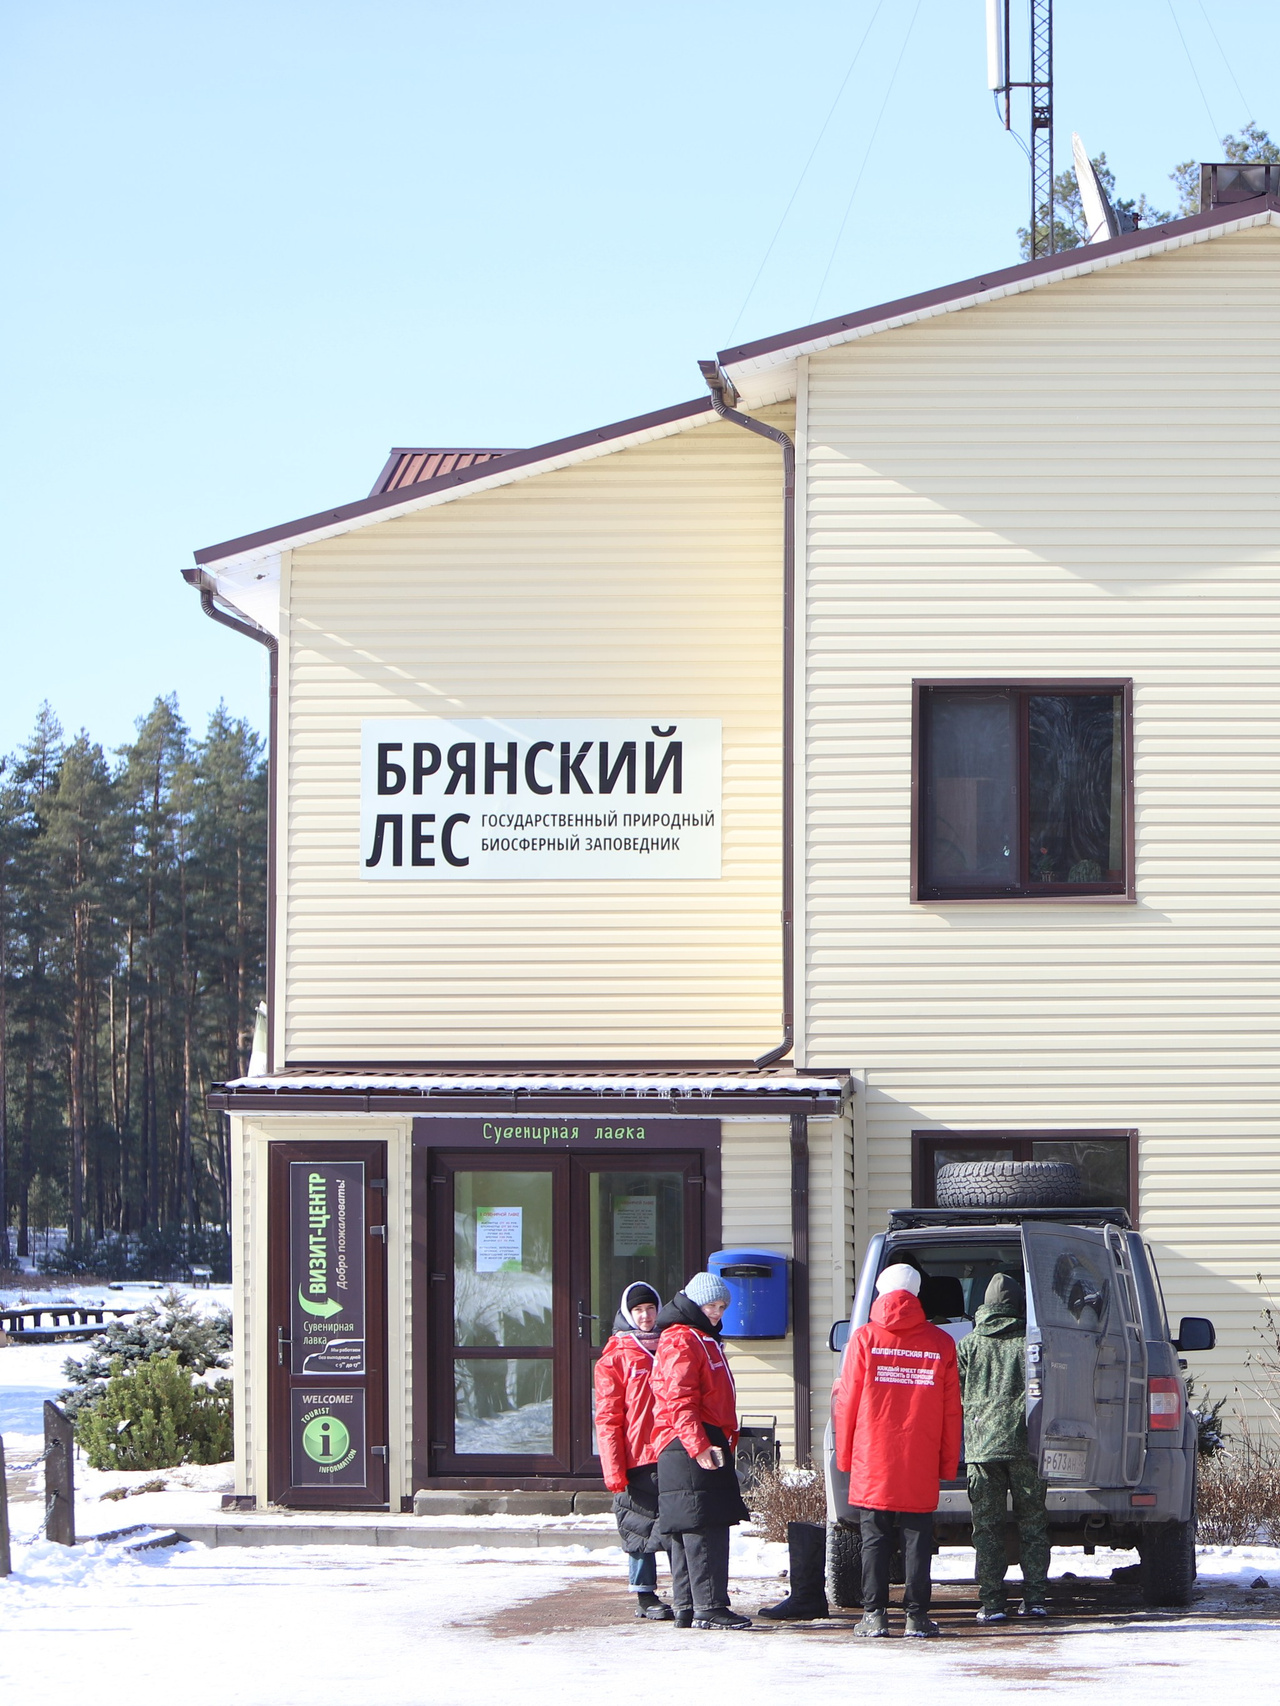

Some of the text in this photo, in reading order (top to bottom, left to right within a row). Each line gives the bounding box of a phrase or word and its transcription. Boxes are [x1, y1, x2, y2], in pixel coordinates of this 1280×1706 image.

[377, 725, 683, 795] БРЯНСКИЙ
[482, 810, 715, 830] ГОСУДАРСТВЕННЫЙ ПРИРОДНЫЙ
[366, 813, 471, 867] ЛЕС
[481, 834, 680, 853] БИОСФЕРНЫЙ ЗАПОВЕДНИК
[483, 1122, 645, 1144] Сувенирная лавка
[309, 1173, 331, 1294] ВИЗИТ-ЦЕНТР
[336, 1179, 348, 1290] Добро пожаловать!
[304, 1321, 354, 1334] Сувенирная
[871, 1347, 941, 1360] ВОЛОНТЕРСКАЯ РОТА
[302, 1395, 353, 1404] WELCOME!
[301, 1407, 329, 1424] TOURIST
[319, 1449, 357, 1473] INFORMATION
